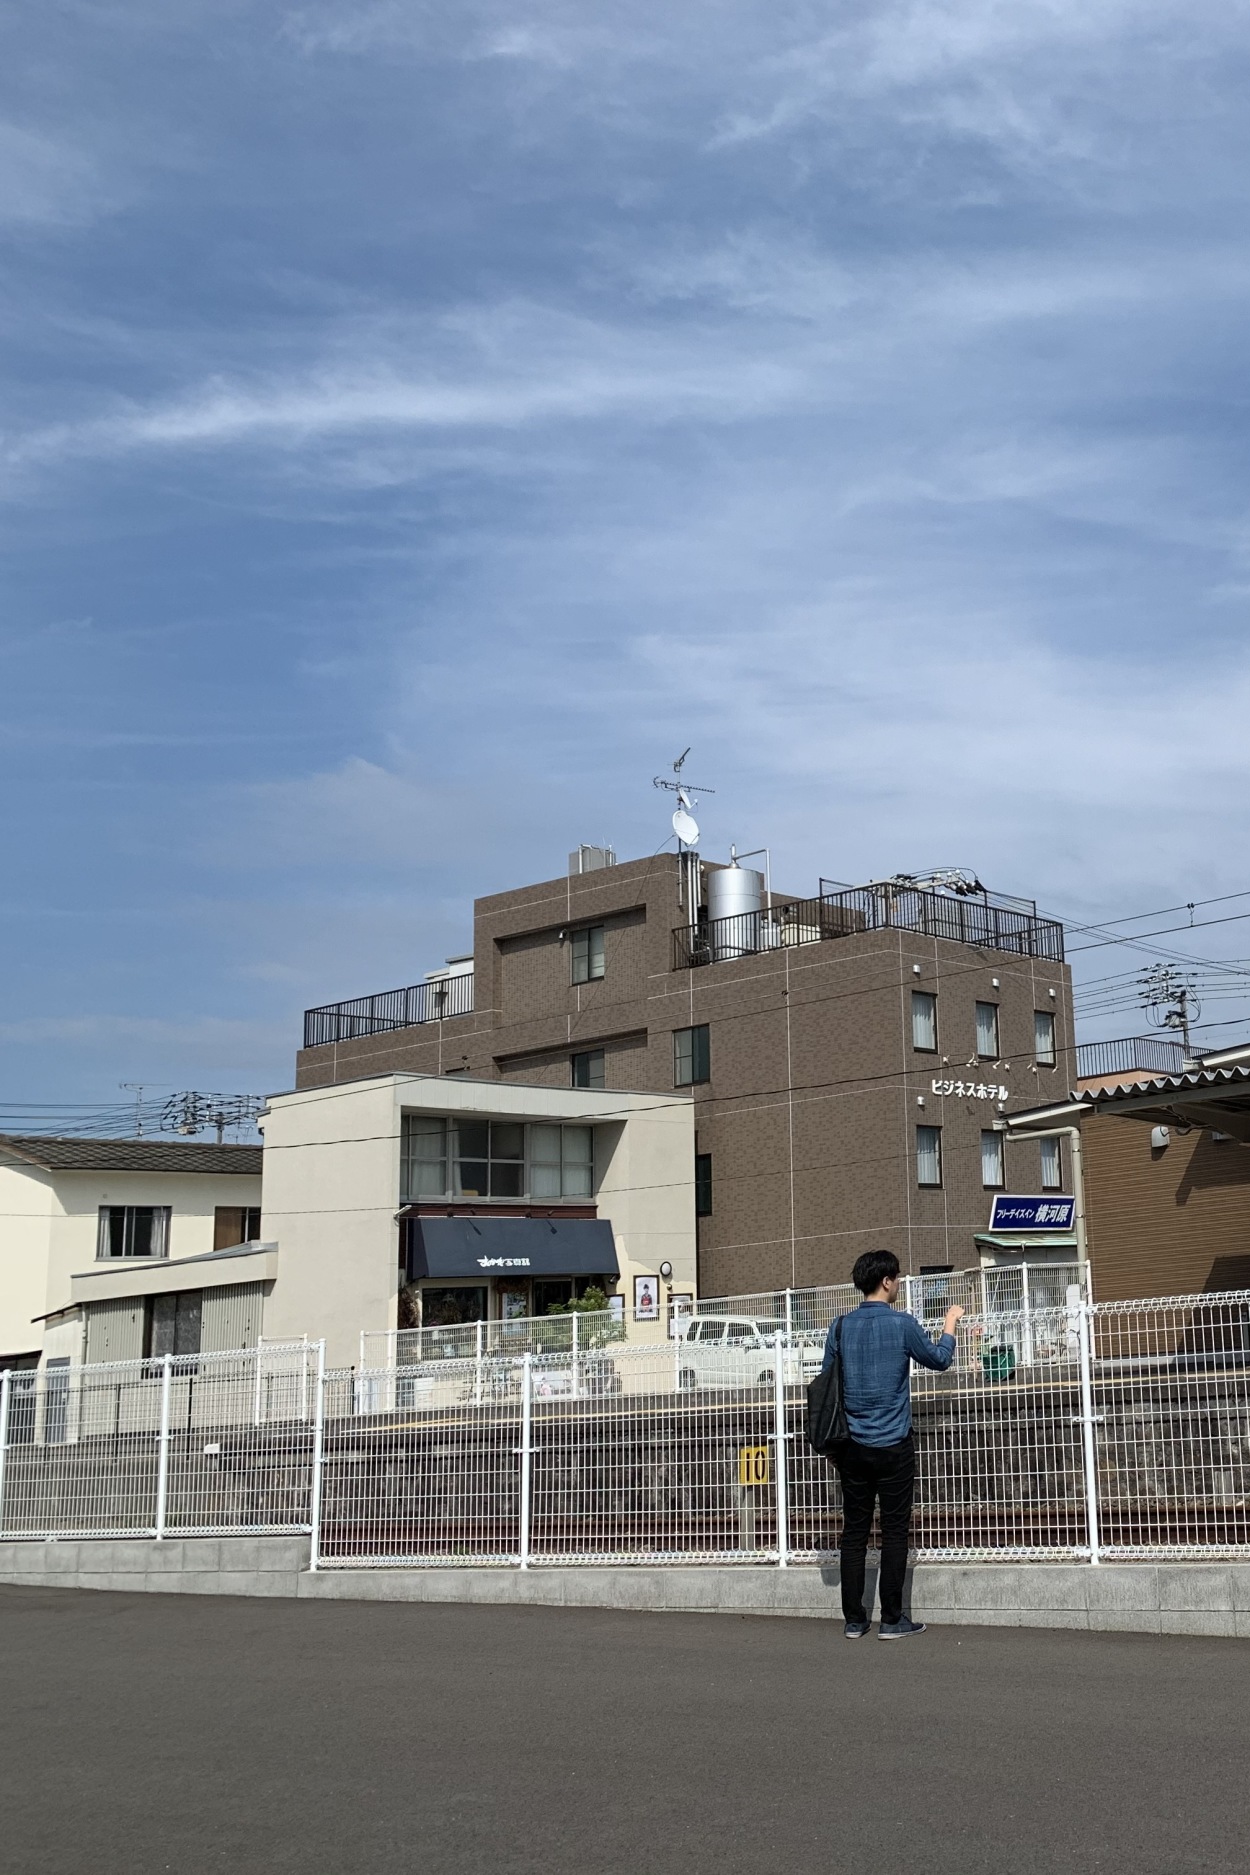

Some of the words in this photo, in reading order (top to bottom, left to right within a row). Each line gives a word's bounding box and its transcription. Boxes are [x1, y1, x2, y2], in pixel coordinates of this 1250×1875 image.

[931, 1079, 1009, 1101] ビジネスホテル
[996, 1208, 1035, 1220] フリーデイズイン
[1034, 1204, 1072, 1223] 横河原
[746, 1450, 766, 1482] 10
